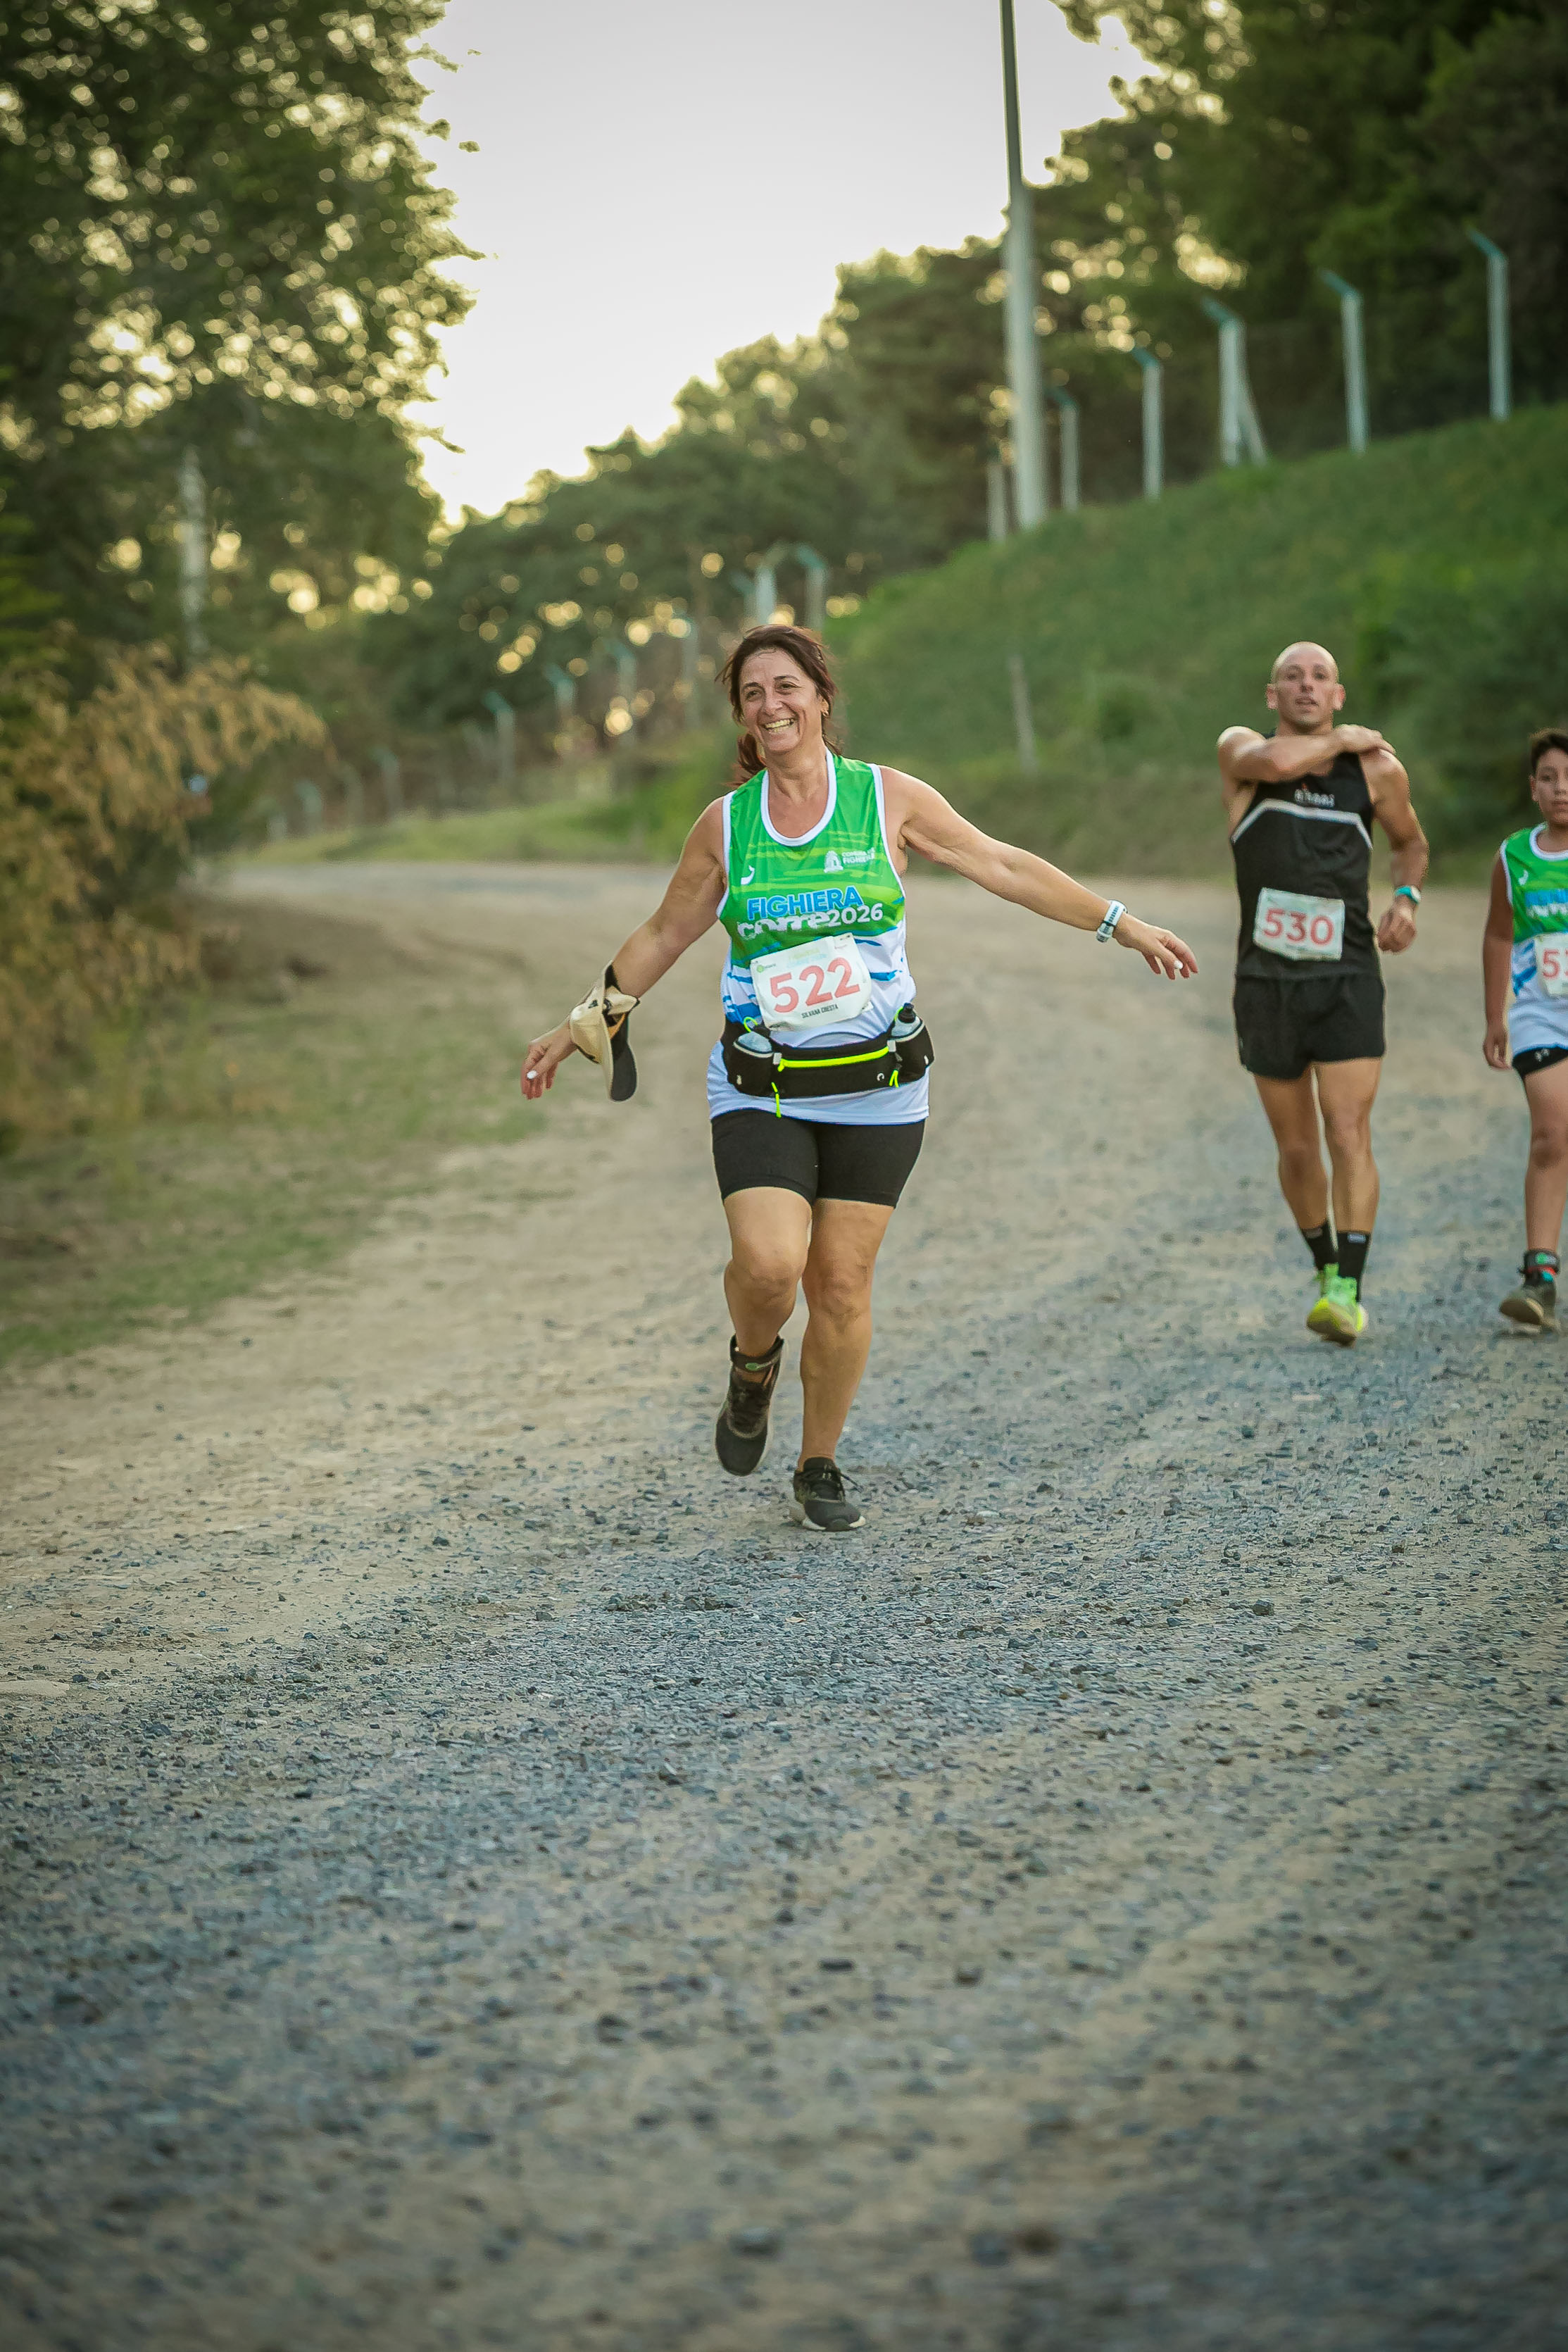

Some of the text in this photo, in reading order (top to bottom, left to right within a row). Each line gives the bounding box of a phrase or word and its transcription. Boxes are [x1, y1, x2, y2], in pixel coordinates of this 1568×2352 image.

[747, 885, 865, 920] FIGHIERA
[1263, 908, 1334, 946] 530
[770, 957, 861, 1013] 522
